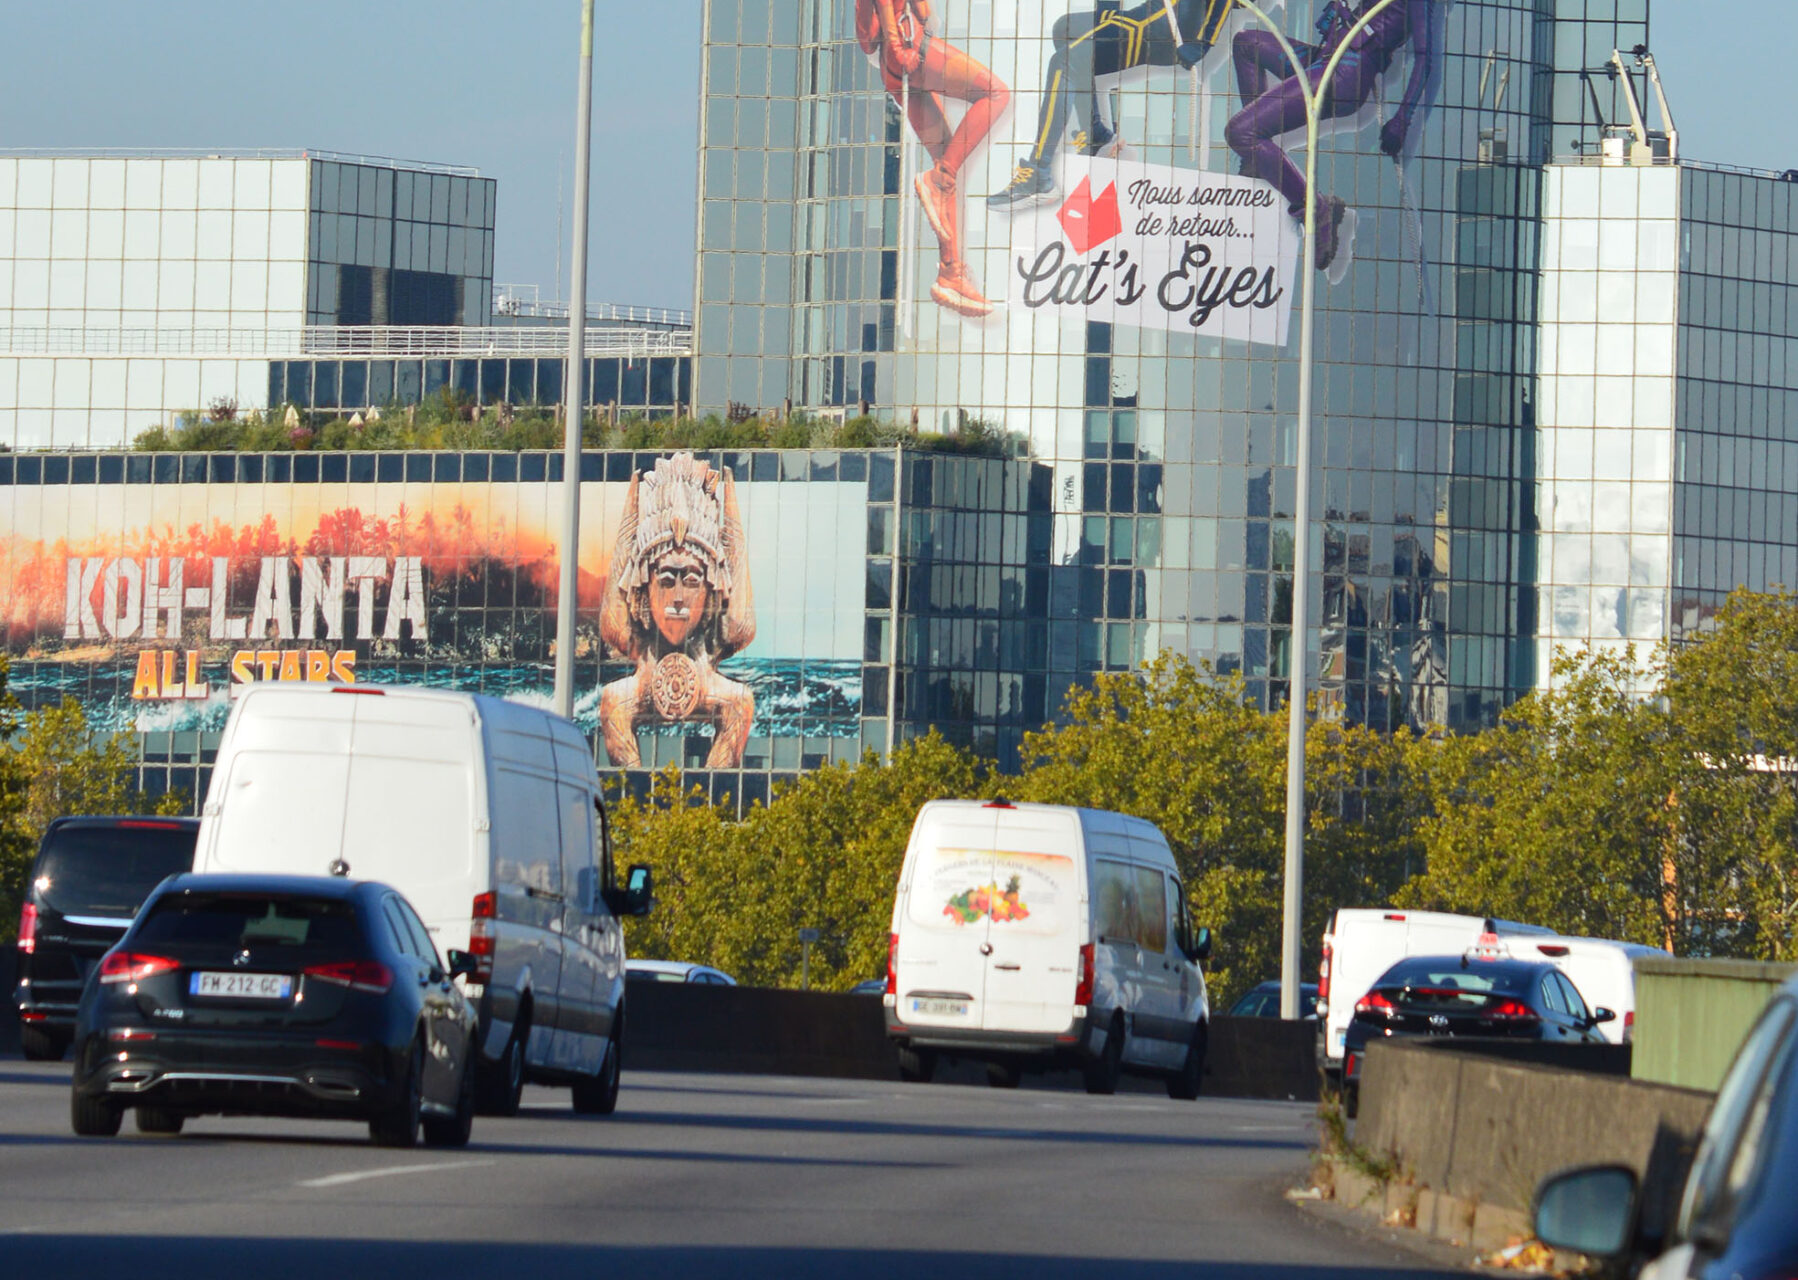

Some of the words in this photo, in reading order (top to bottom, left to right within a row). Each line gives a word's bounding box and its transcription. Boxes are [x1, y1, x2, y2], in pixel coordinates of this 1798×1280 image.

[1128, 179, 1184, 209] Nous
[1186, 187, 1274, 208] sommes
[1135, 212, 1163, 237] de
[1165, 213, 1255, 239] retour...
[1017, 240, 1146, 308] Cat's
[1157, 240, 1283, 327] Eyes
[63, 556, 428, 639] KOH-LANTA
[132, 649, 208, 699] ALL
[231, 649, 357, 698] STARS
